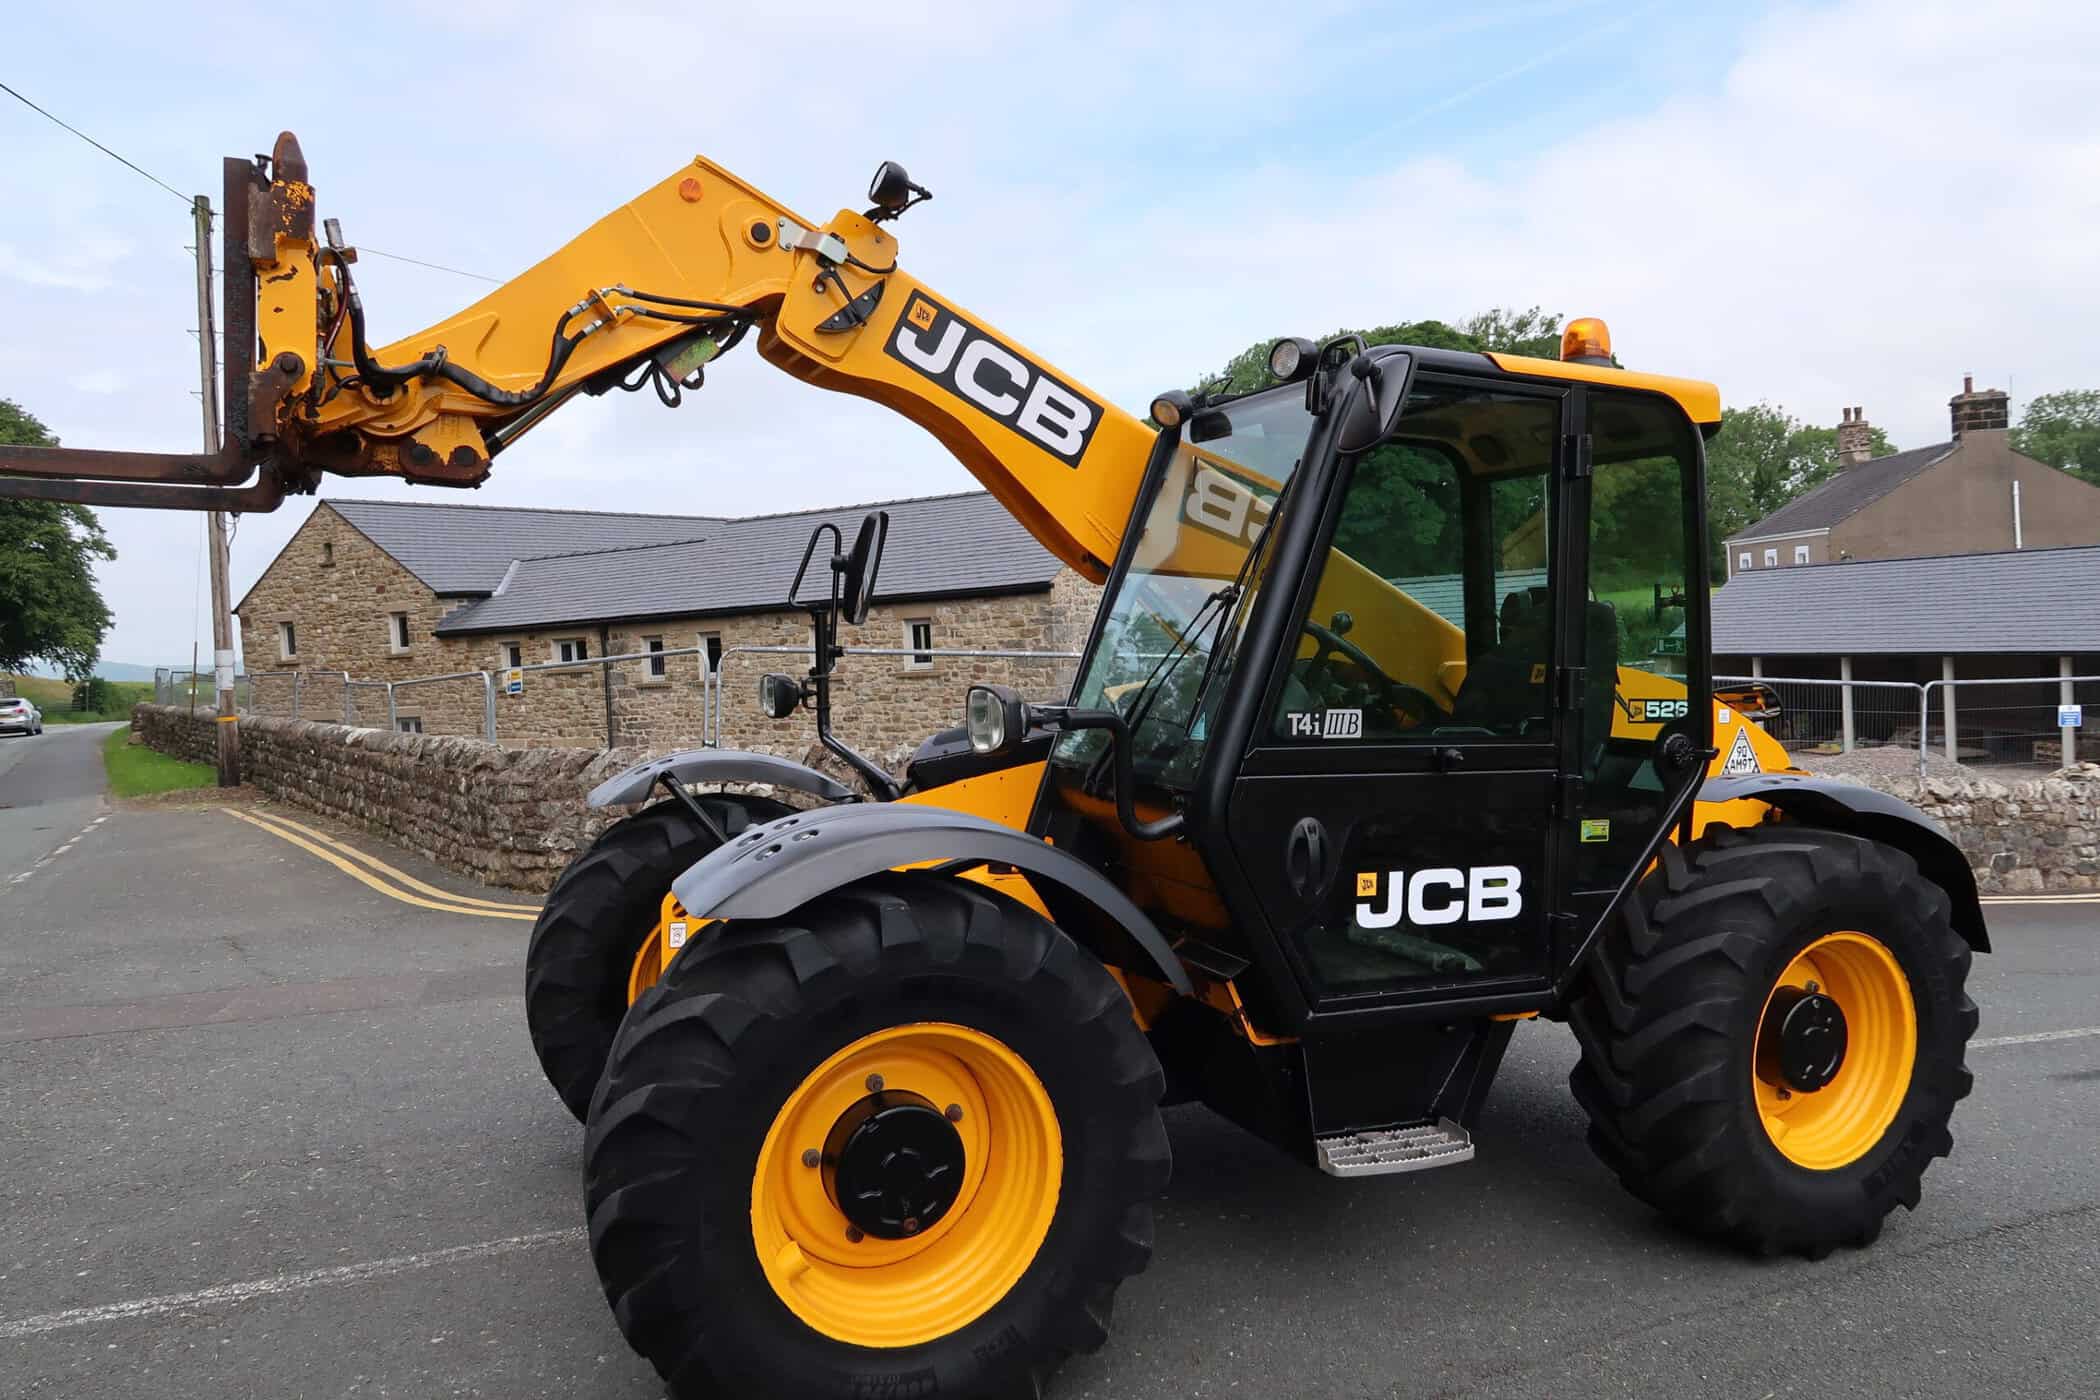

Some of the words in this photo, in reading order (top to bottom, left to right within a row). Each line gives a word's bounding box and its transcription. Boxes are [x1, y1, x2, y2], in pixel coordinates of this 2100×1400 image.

[896, 320, 1091, 456] JCB
[1287, 713, 1321, 736] T4i
[1355, 864, 1522, 929] JCB
